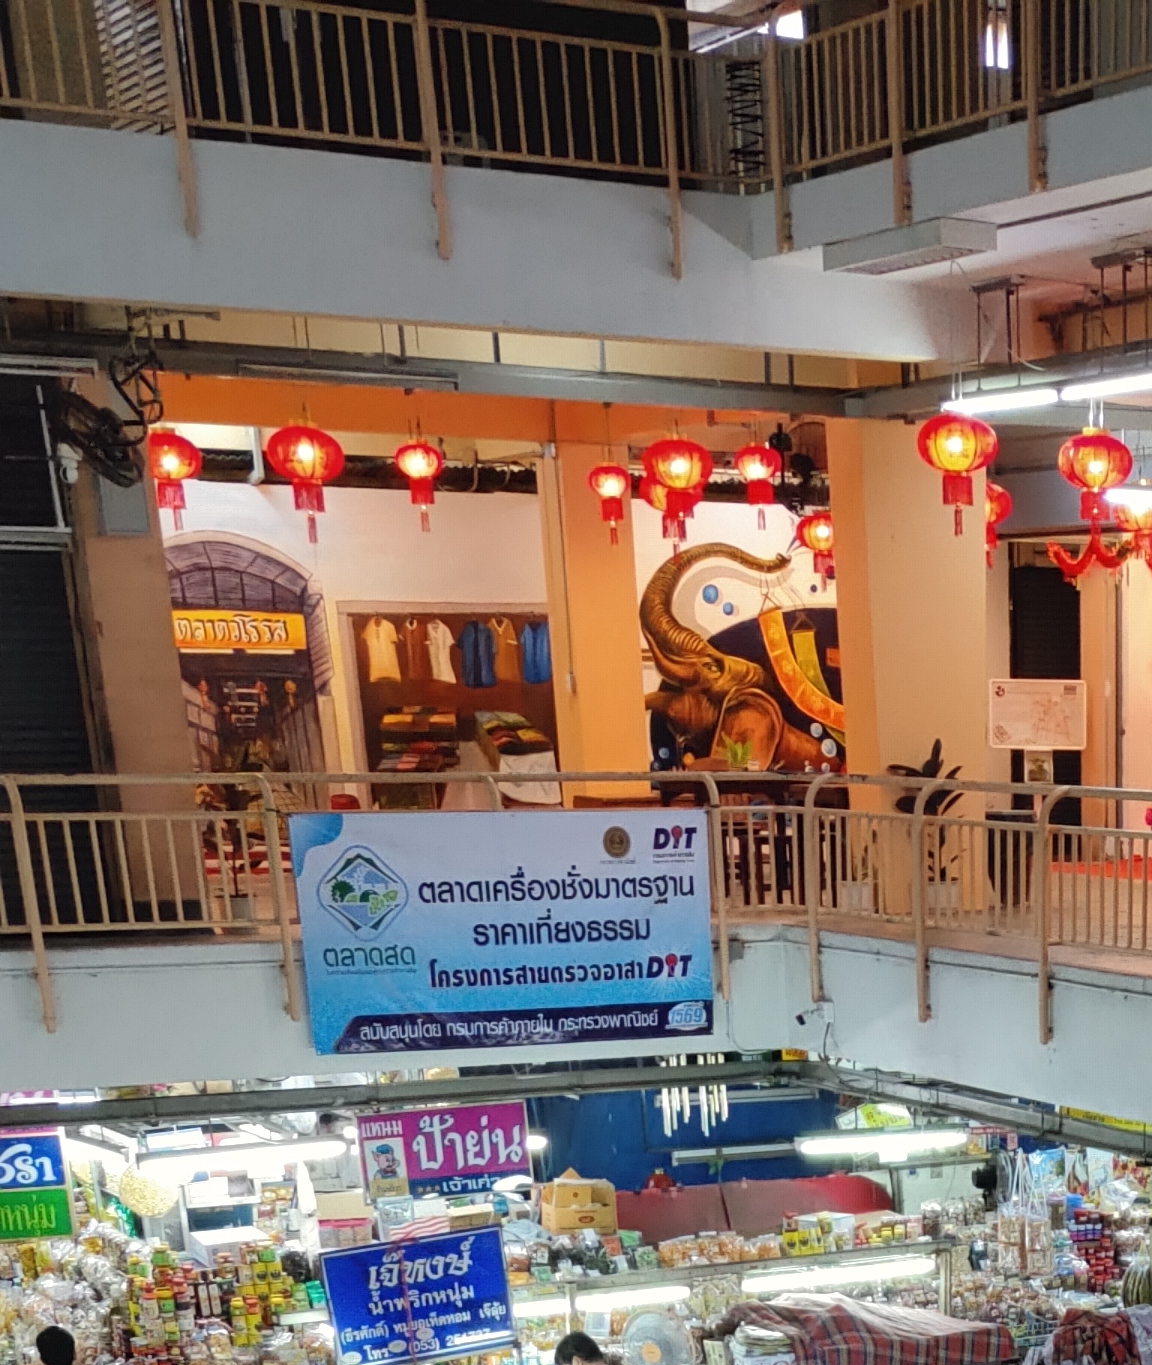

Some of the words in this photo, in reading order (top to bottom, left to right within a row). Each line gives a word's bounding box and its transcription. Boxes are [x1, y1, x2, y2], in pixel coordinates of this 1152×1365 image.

[175, 613, 290, 643] ตลาดวโรรส
[418, 866, 695, 904] ตลาดเครื่องชั่งมาตรฐาน
[473, 908, 651, 946] ราคาเที่ยงธรรม
[322, 944, 416, 967] ตลาดสด
[428, 959, 643, 988] โครงการสายตรวจอาสา
[360, 1018, 441, 1044] สนับสนุนโดย
[558, 1008, 659, 1035] กระทรวงพาณิชย์
[668, 1007, 703, 1024] 1569
[361, 1119, 404, 1138] แหนม
[411, 1113, 523, 1171] ป้าย่น
[368, 1282, 475, 1316] น้ำพริกหนุ่ม
[409, 1338, 441, 1353] (053)
